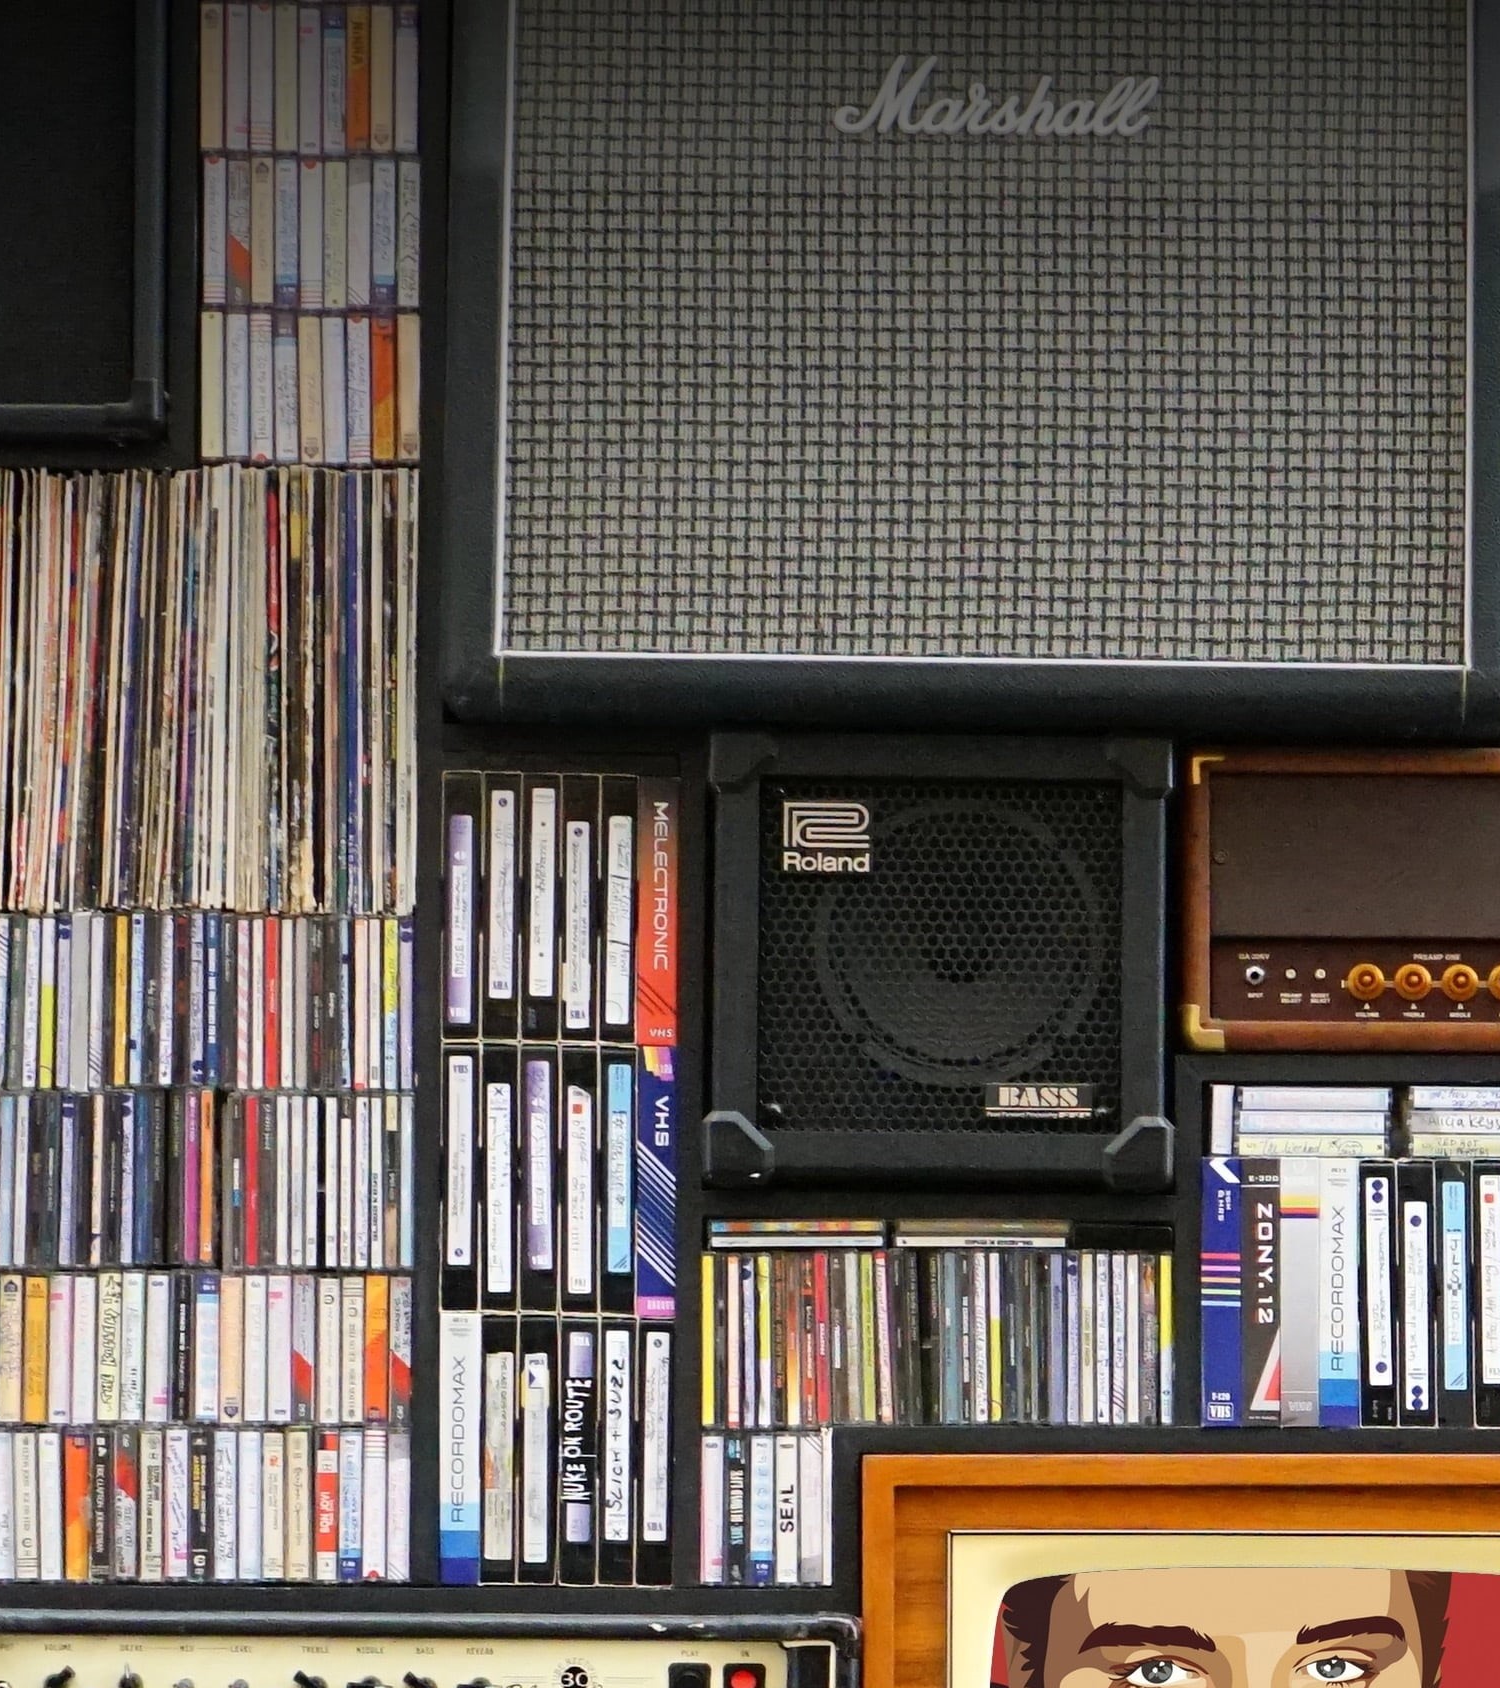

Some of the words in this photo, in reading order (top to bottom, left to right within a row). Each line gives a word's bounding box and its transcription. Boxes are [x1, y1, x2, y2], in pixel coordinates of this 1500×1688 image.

[833, 54, 1160, 138] Marshall
[652, 801, 670, 971] MELECTRONIC
[782, 853, 870, 874] Roland
[649, 1028, 674, 1038] VHS
[654, 1096, 670, 1147] VHS
[998, 1086, 1078, 1108] BASS
[1256, 1202, 1274, 1325] ZONY.12
[1331, 1206, 1345, 1372] RECORDOMAX
[572, 1377, 593, 1427] ROUTE
[451, 1355, 466, 1523] RECORDOMAX
[779, 1484, 795, 1533] SEAL
